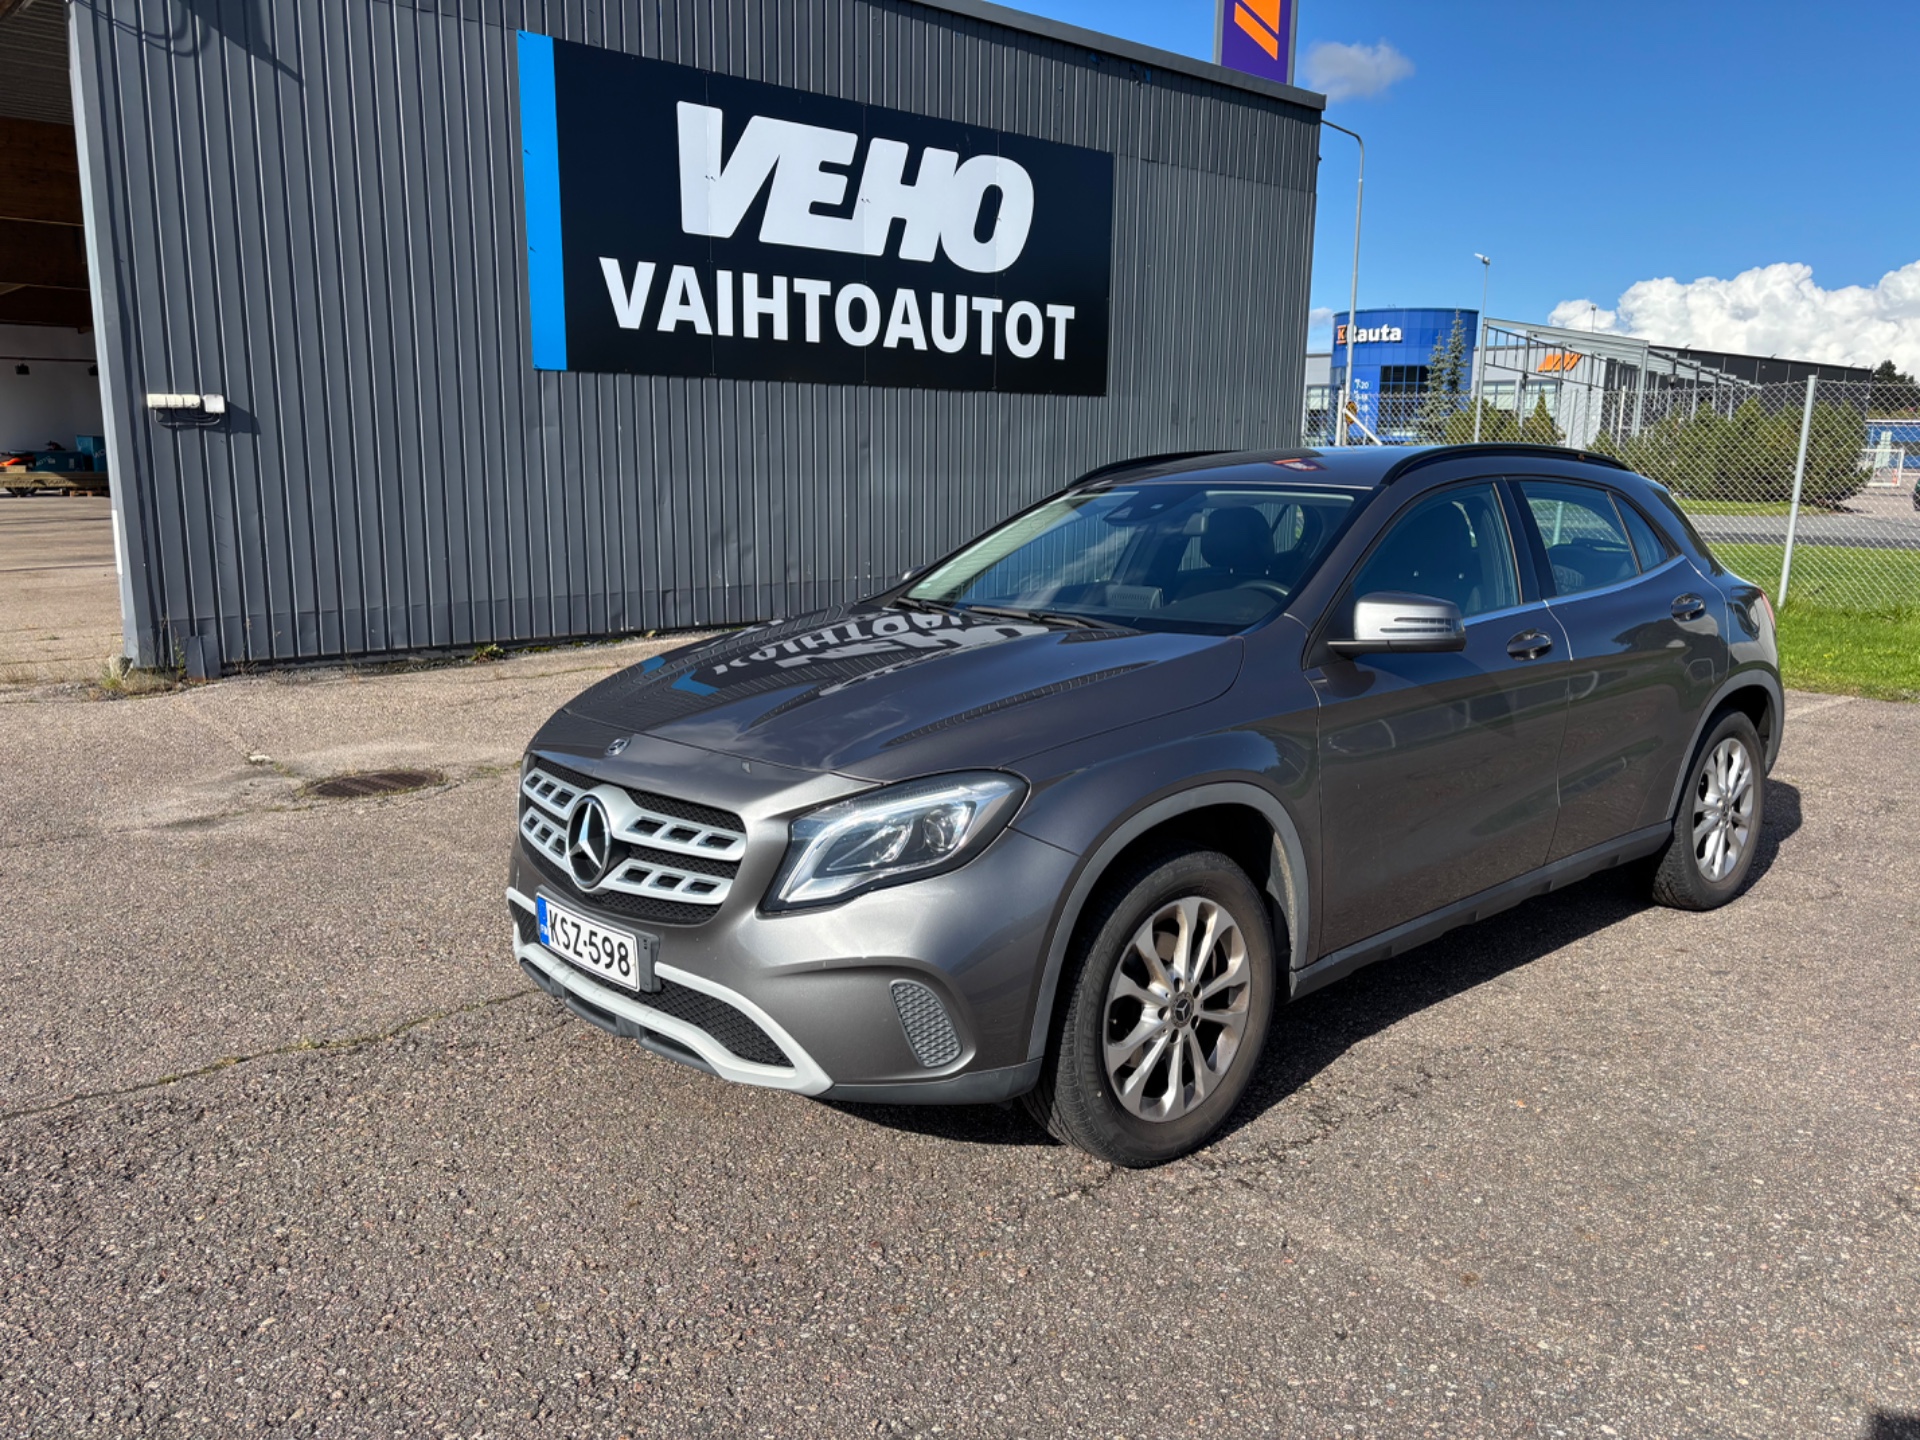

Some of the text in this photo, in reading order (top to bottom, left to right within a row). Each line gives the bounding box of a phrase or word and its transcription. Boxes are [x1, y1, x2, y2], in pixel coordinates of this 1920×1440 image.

[677, 100, 1034, 273] VEHO
[599, 256, 1076, 360] VAIHTOAUTOT
[549, 909, 631, 977] KSZ-598
